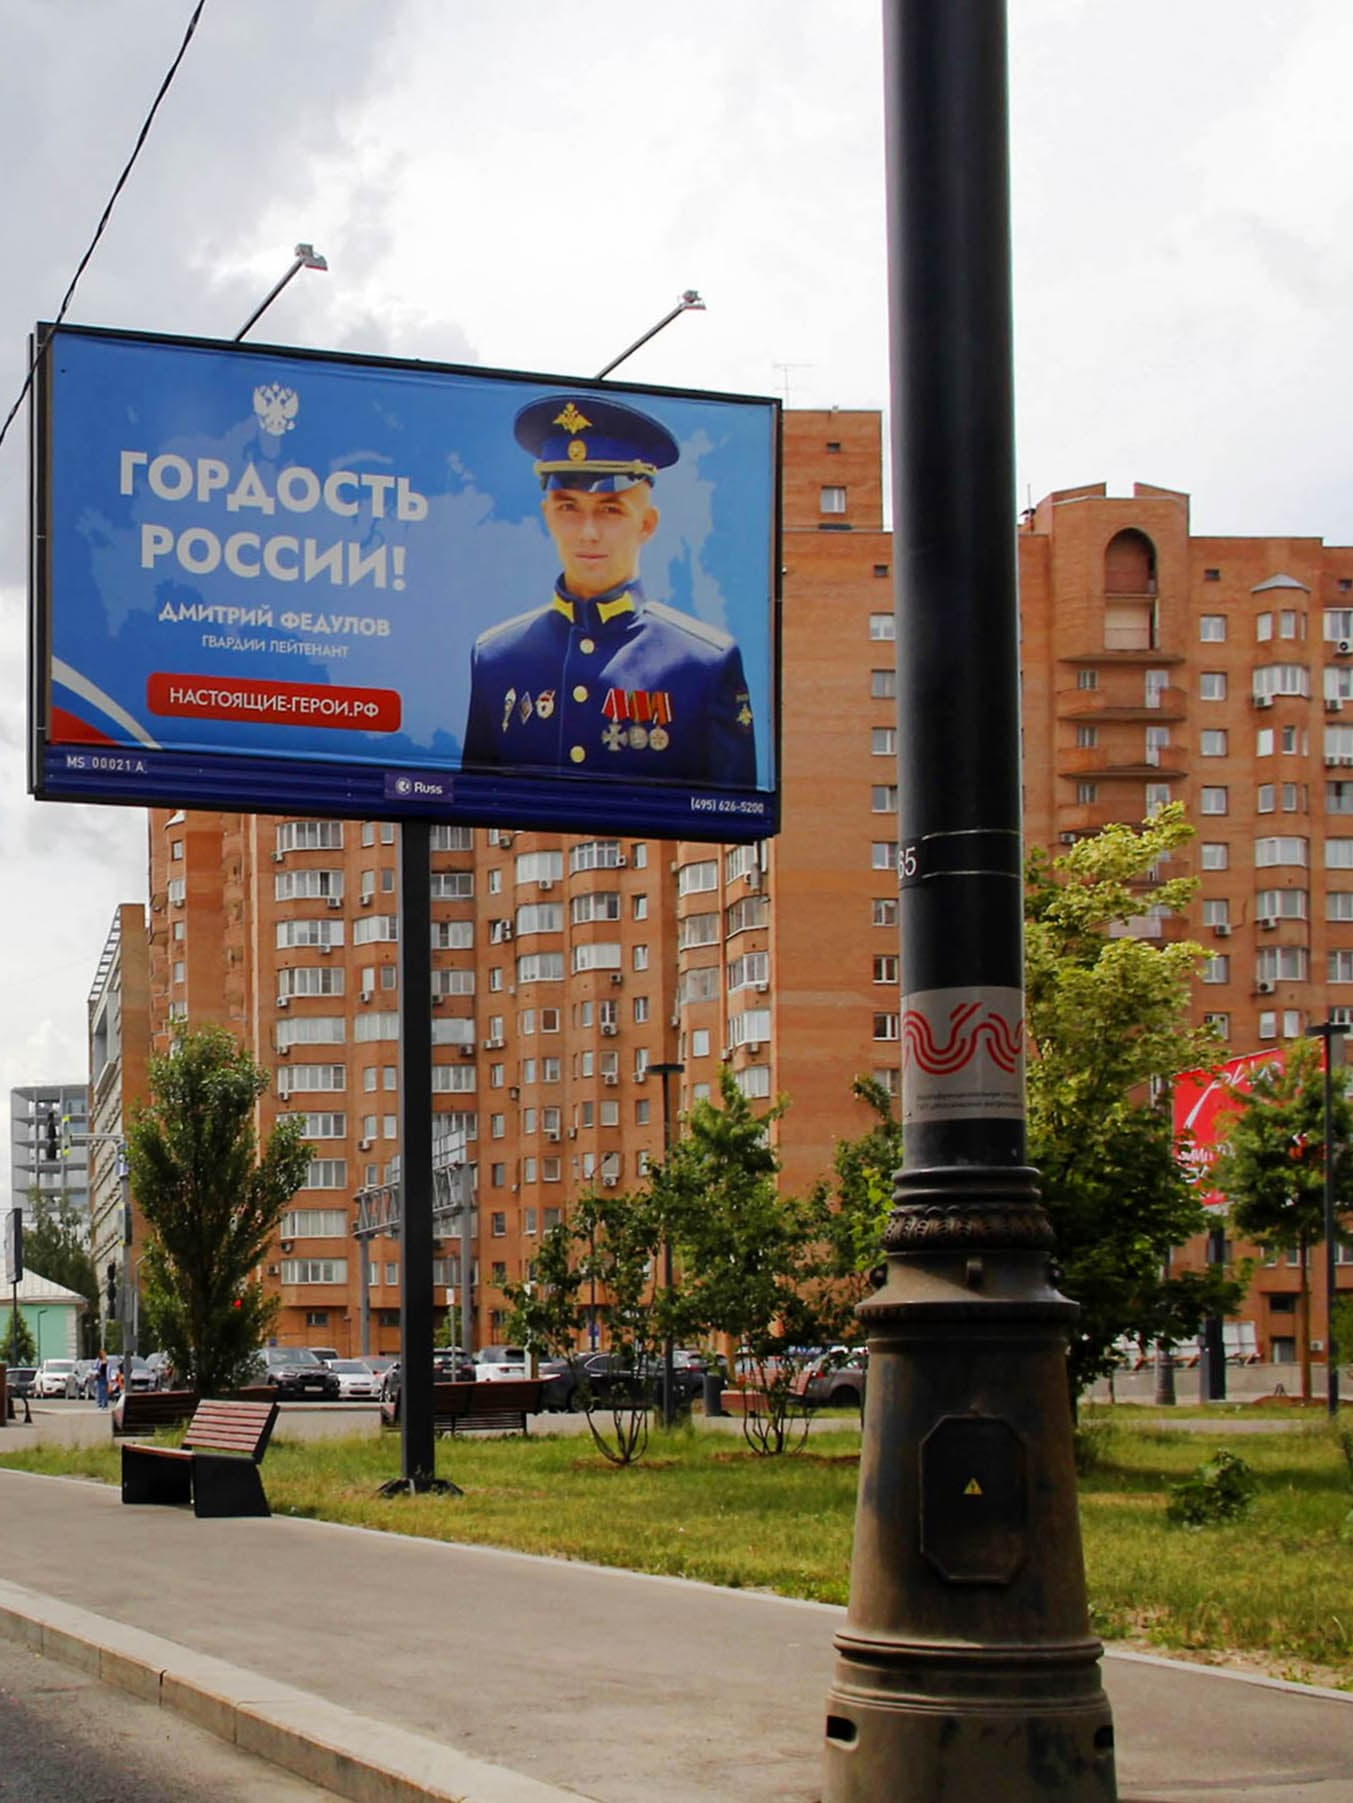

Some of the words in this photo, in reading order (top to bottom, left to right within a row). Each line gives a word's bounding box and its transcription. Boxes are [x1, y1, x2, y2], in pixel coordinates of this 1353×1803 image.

[119, 449, 429, 521] ГОРДОСТЬ
[140, 523, 406, 591] РОССИИ!
[158, 600, 273, 628] ДМИТРИЙ
[280, 611, 392, 638] ФЕДУЛОВ
[201, 634, 266, 653] ГВАРДИИ
[269, 638, 350, 659] ЛЕЙТЕНАНТ
[169, 687, 380, 718] НАСТОЯЩИЕ-ГЕРОИ.РФ
[66, 755, 85, 769] MS
[91, 756, 131, 771] 00021
[414, 781, 443, 795] Russ
[690, 796, 717, 811] (495)
[718, 799, 764, 814] 626-5200
